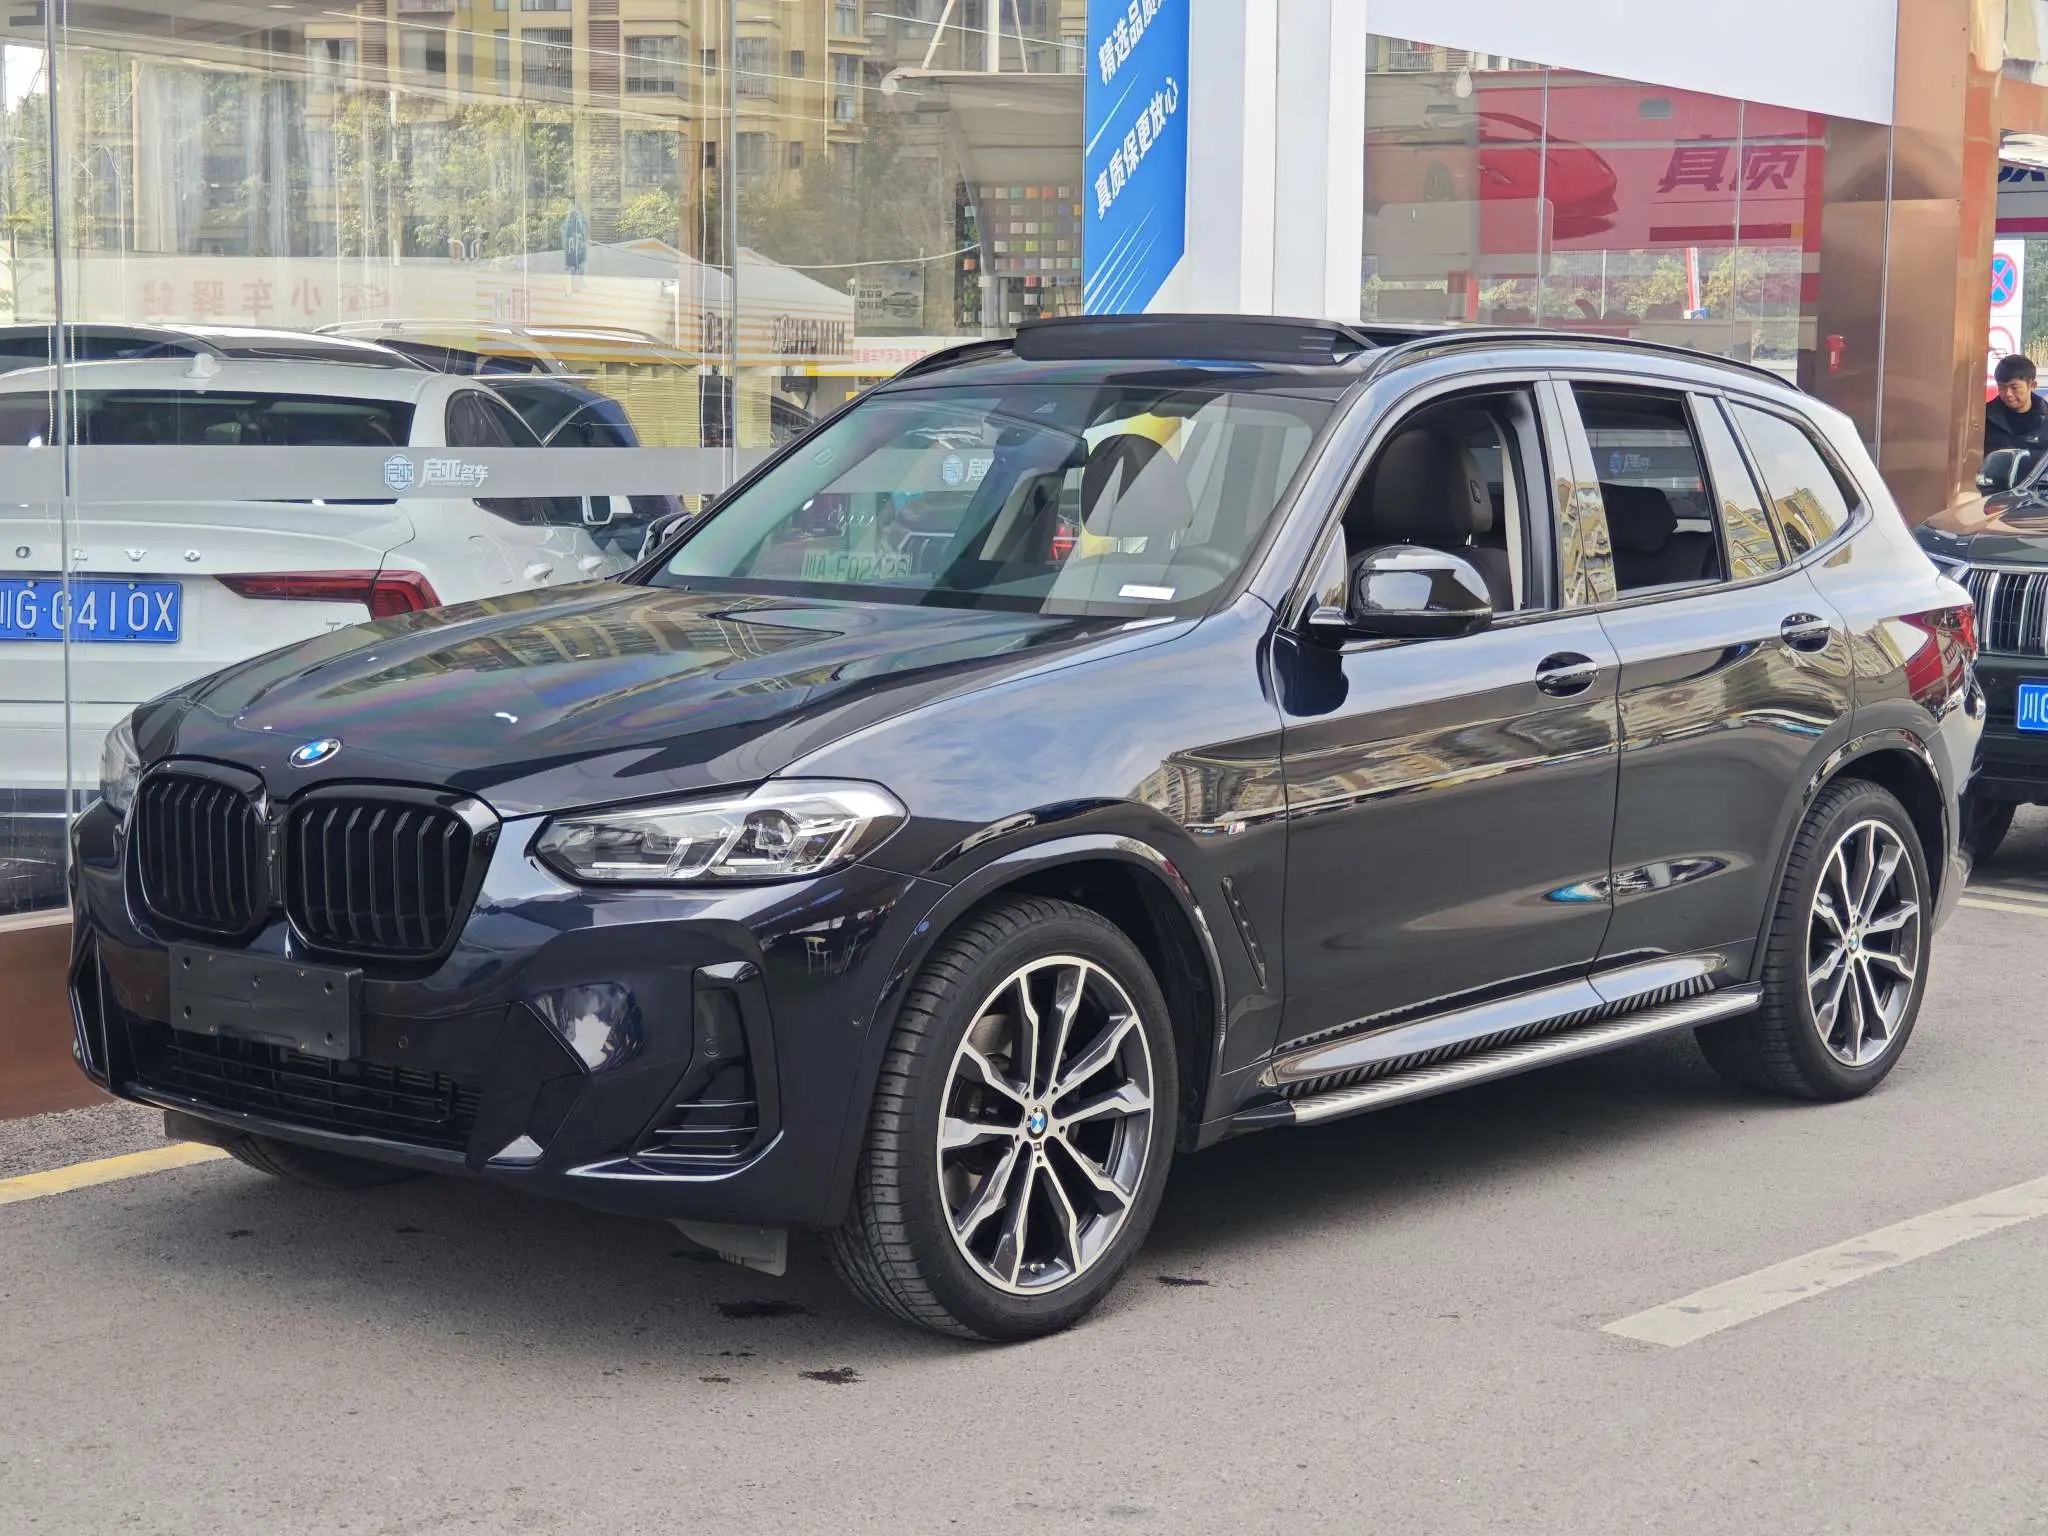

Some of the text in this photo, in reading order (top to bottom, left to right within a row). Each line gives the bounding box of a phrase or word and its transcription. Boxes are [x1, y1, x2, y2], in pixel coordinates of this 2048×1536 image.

[1098, 0, 1166, 86] 精选品质
[1095, 76, 1179, 220] 真质保更放心
